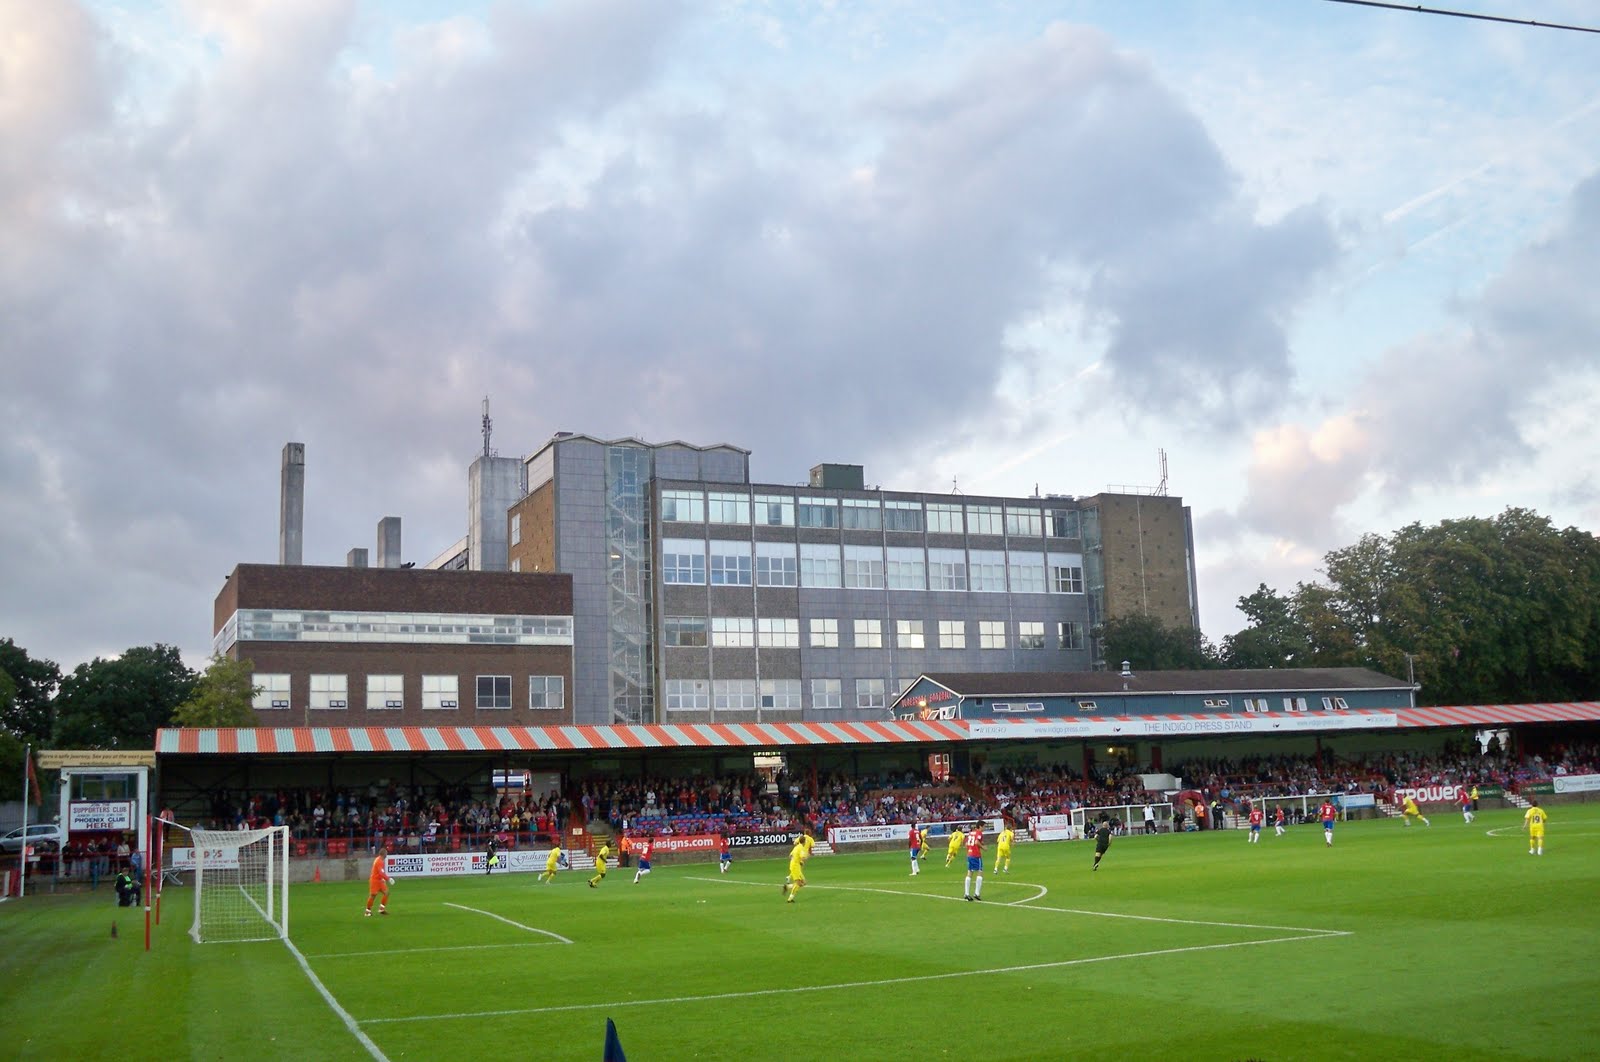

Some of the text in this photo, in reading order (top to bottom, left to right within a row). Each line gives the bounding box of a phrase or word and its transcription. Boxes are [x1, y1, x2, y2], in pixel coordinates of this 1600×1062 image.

[1144, 720, 1252, 732] THE INDIGO PRESS STAND
[1532, 815, 1540, 824] 19
[754, 834, 786, 844] 336000
[968, 836, 975, 846] 23
